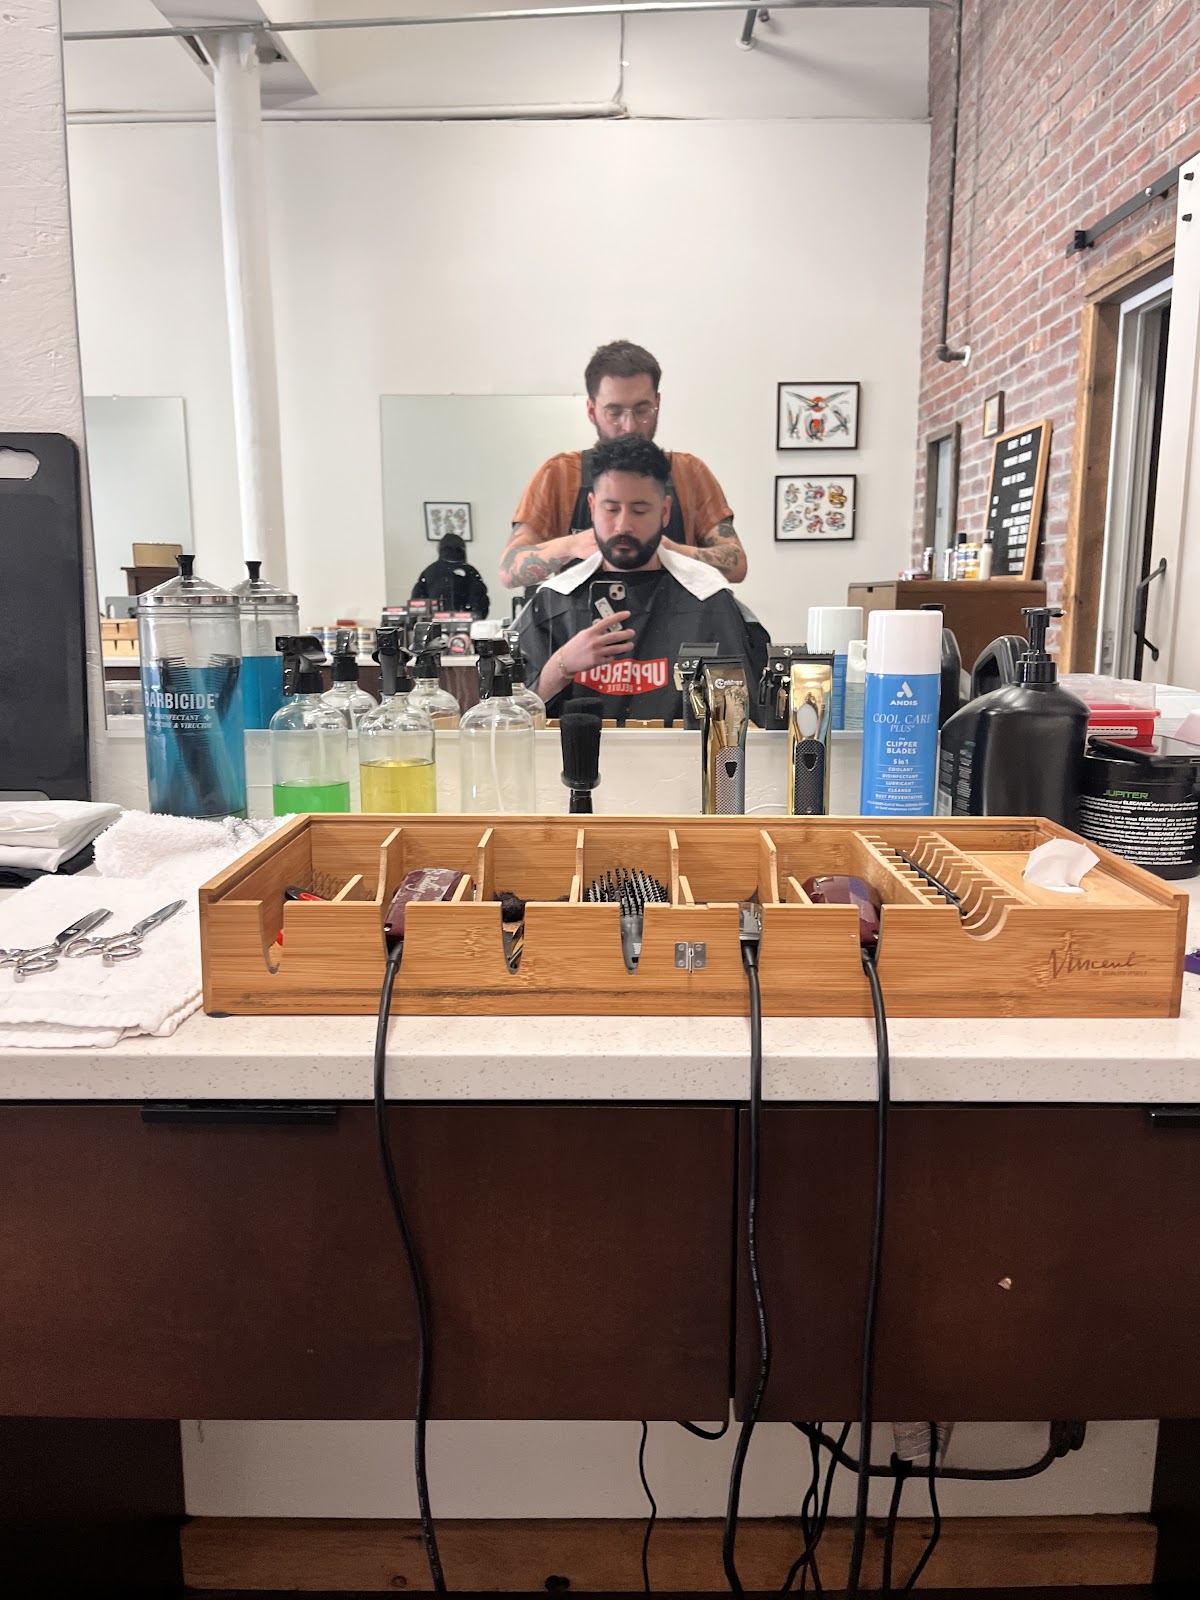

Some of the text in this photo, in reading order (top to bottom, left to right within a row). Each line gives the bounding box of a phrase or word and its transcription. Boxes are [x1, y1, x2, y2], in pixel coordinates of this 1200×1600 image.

[144, 690, 215, 710] BARBICIDE
[873, 713, 933, 724] COOL CARE
[1102, 789, 1149, 800] JUPITER
